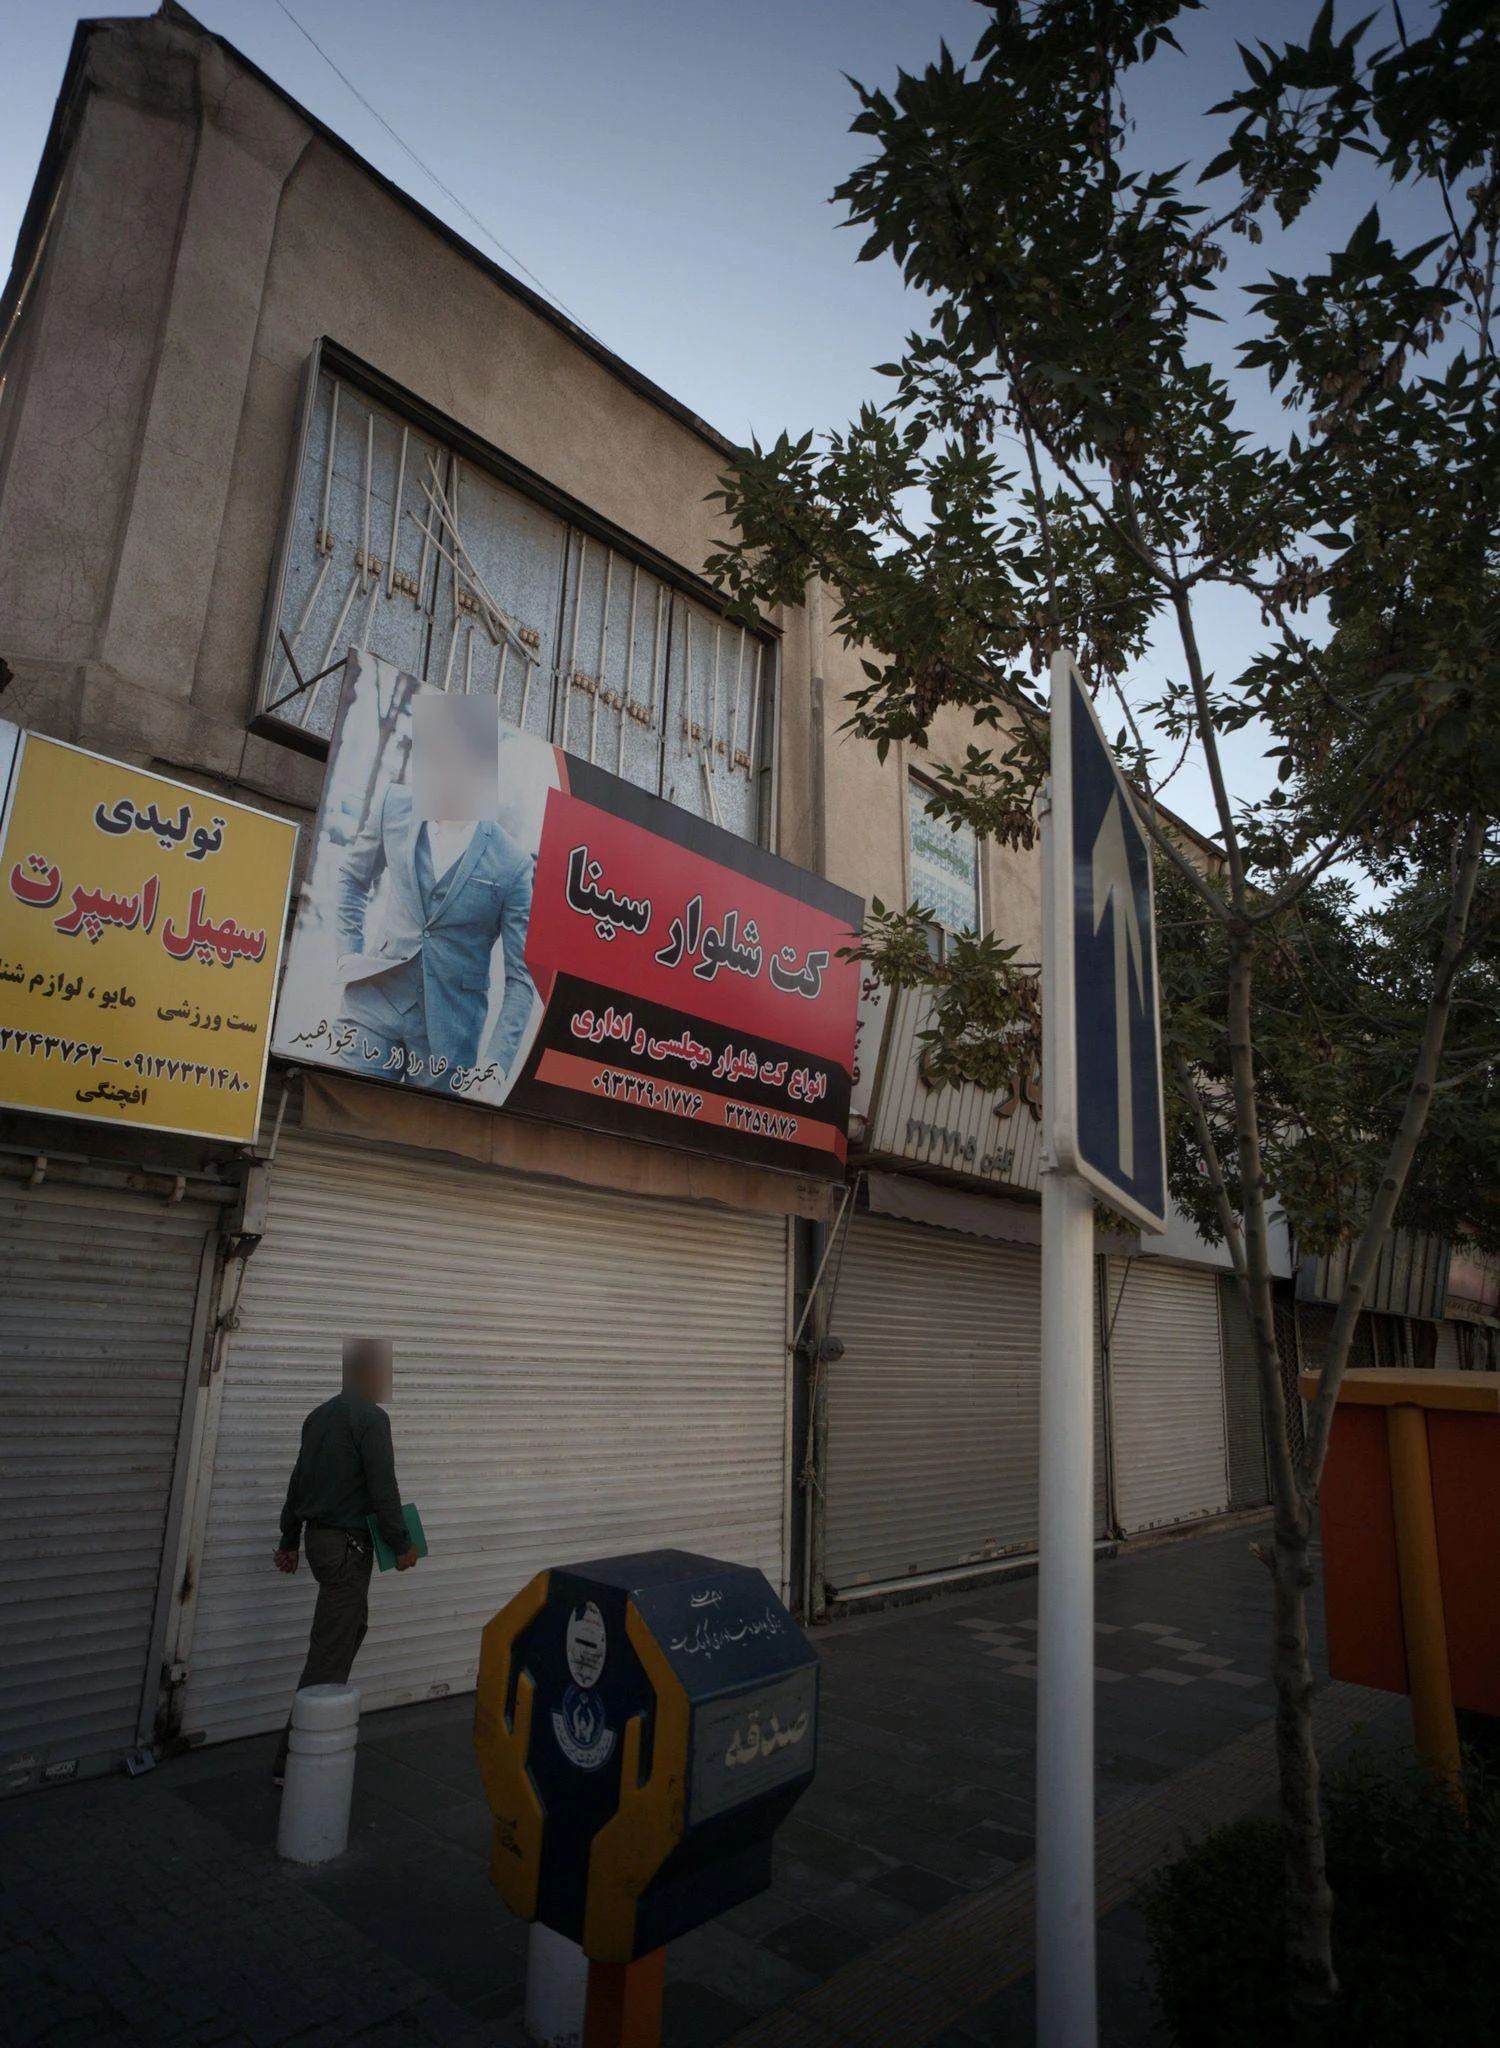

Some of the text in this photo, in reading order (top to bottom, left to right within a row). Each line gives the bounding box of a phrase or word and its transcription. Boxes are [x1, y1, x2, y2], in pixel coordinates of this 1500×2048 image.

[94, 798, 226, 860] تولیدی
[9, 853, 267, 968] سهیل اسپرت
[565, 845, 829, 999] کت شلوار سینا
[29, 972, 83, 1001] لوازم
[157, 1002, 258, 1033] ست ورزشی
[288, 1018, 501, 1092] بهترین ها را از ما بخواهید
[571, 1007, 827, 1103] انواع کت شلوار مجلسی و اداری
[75, 1082, 147, 1109] افچنگی
[592, 1069, 798, 1140] ۰۹۳۳۲۹۰۱۷۷۶ ۳۲۲۵۹۸۷۶
[725, 1710, 809, 1769] صدقه
